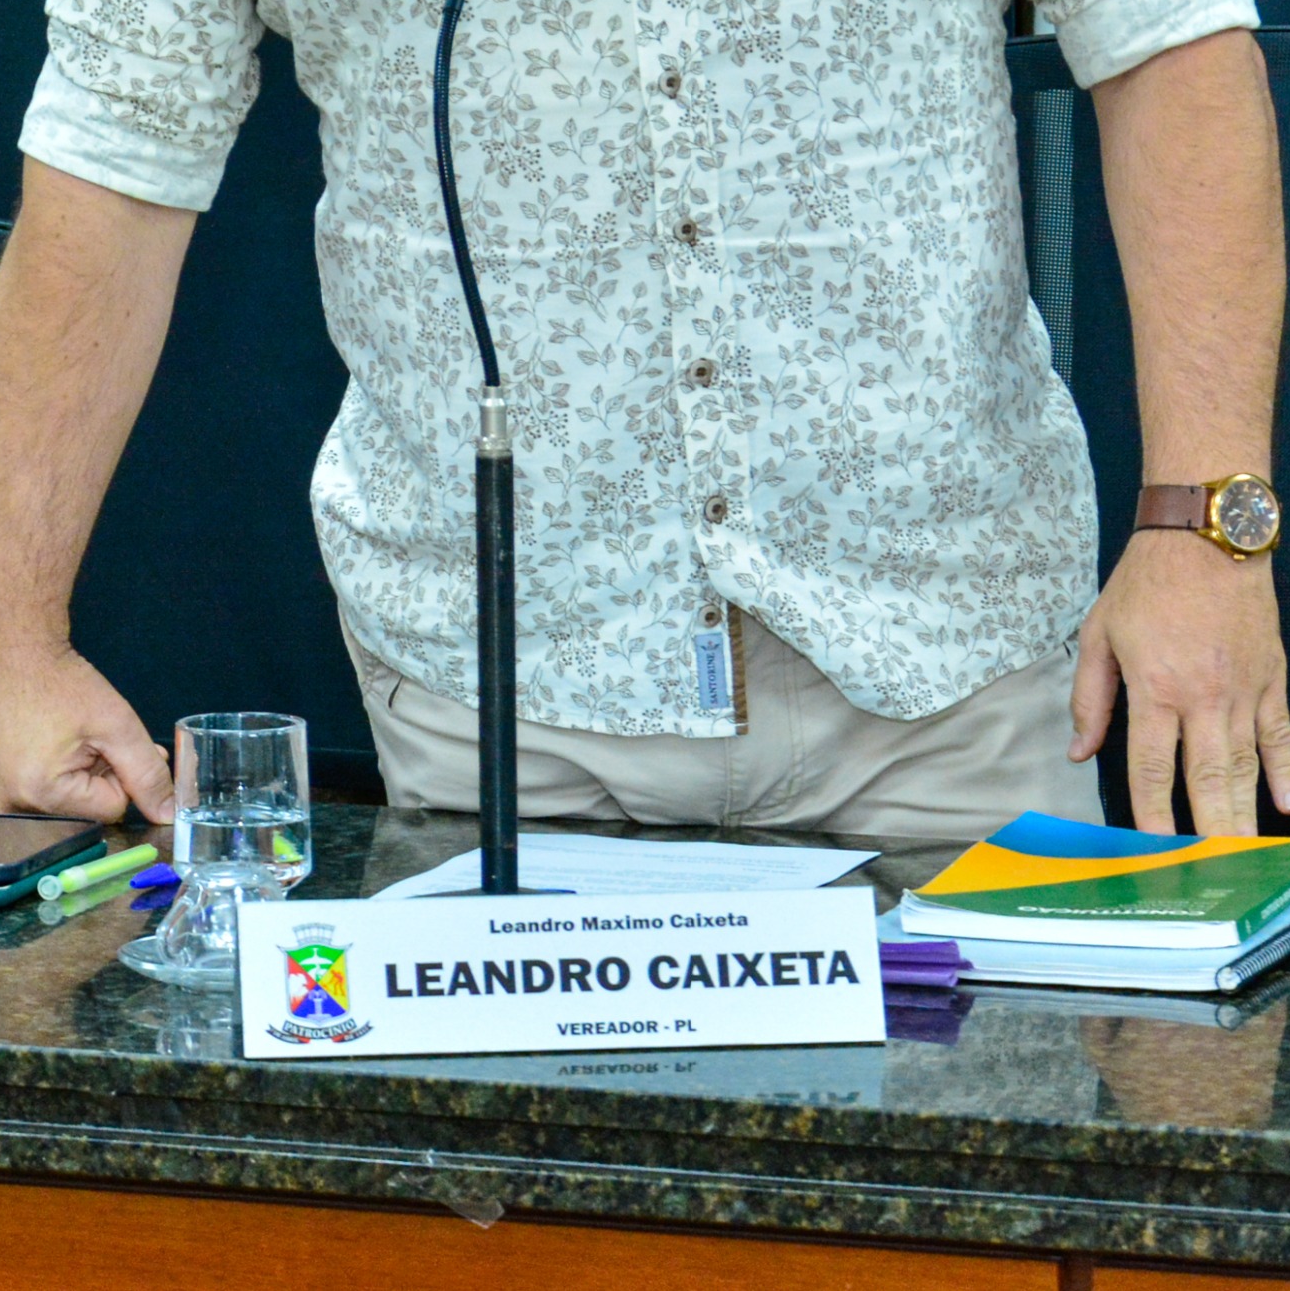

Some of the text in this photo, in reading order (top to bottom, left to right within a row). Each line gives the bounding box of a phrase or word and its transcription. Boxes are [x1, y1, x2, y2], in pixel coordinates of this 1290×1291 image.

[489, 912, 749, 934] Leandro Maximo Caixeta
[385, 950, 860, 998] LEANDRO CAIXETA
[557, 1020, 658, 1036] VEREADOR
[674, 1019, 697, 1033] PL
